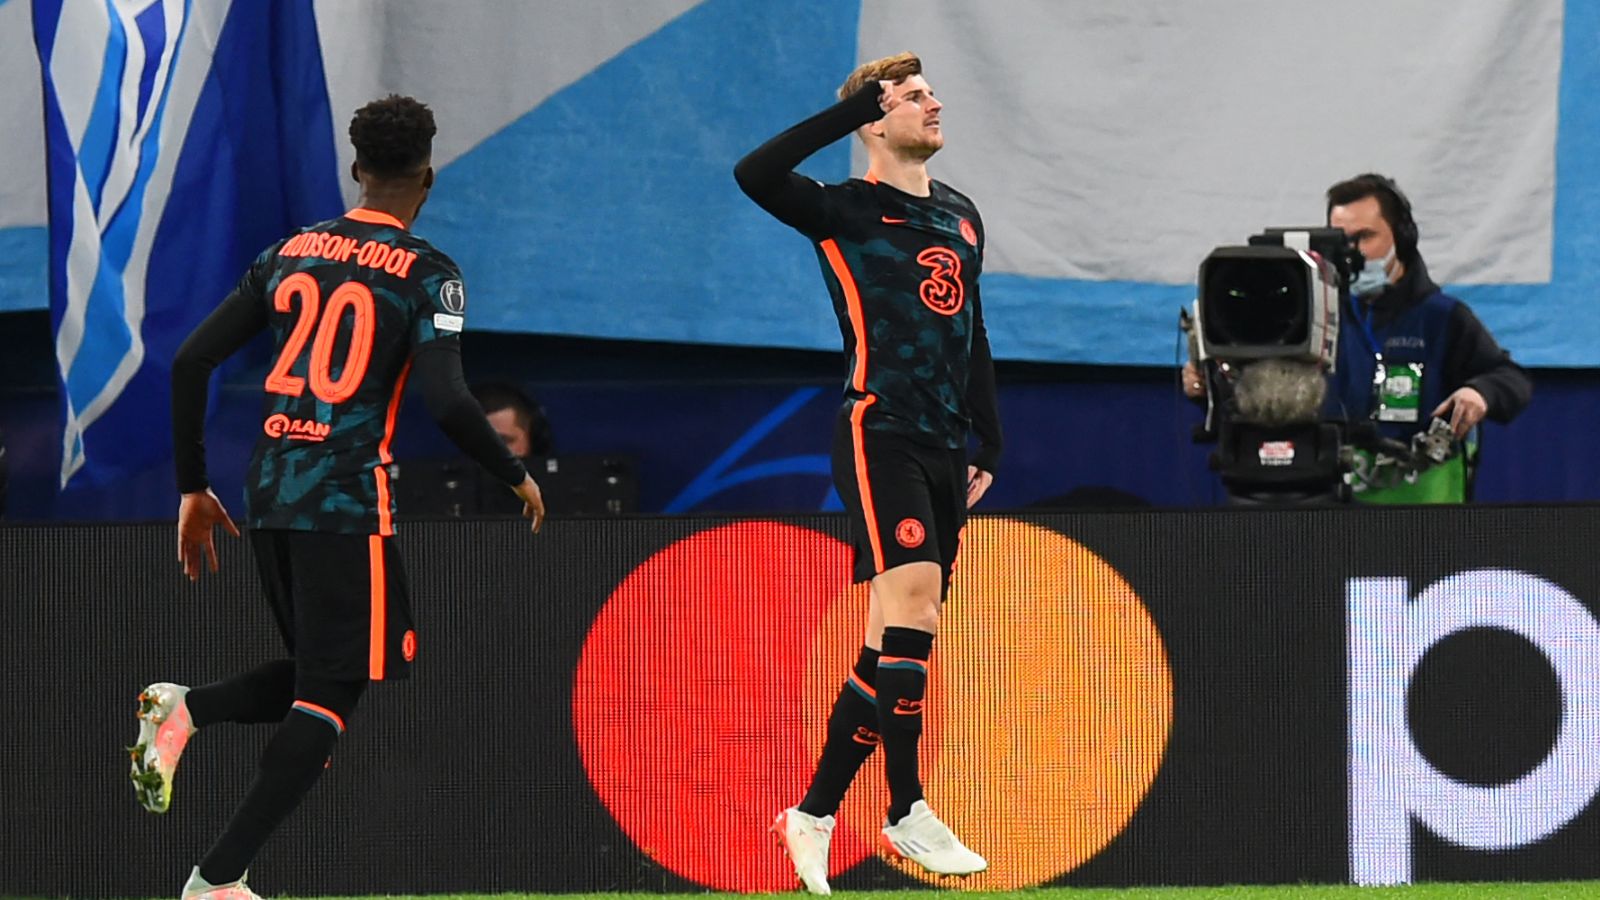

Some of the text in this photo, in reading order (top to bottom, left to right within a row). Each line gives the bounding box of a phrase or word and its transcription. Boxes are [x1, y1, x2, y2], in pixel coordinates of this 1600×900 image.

[279, 232, 417, 278] HUDSON-ODOI
[917, 247, 964, 316] 3
[265, 272, 376, 404] 20
